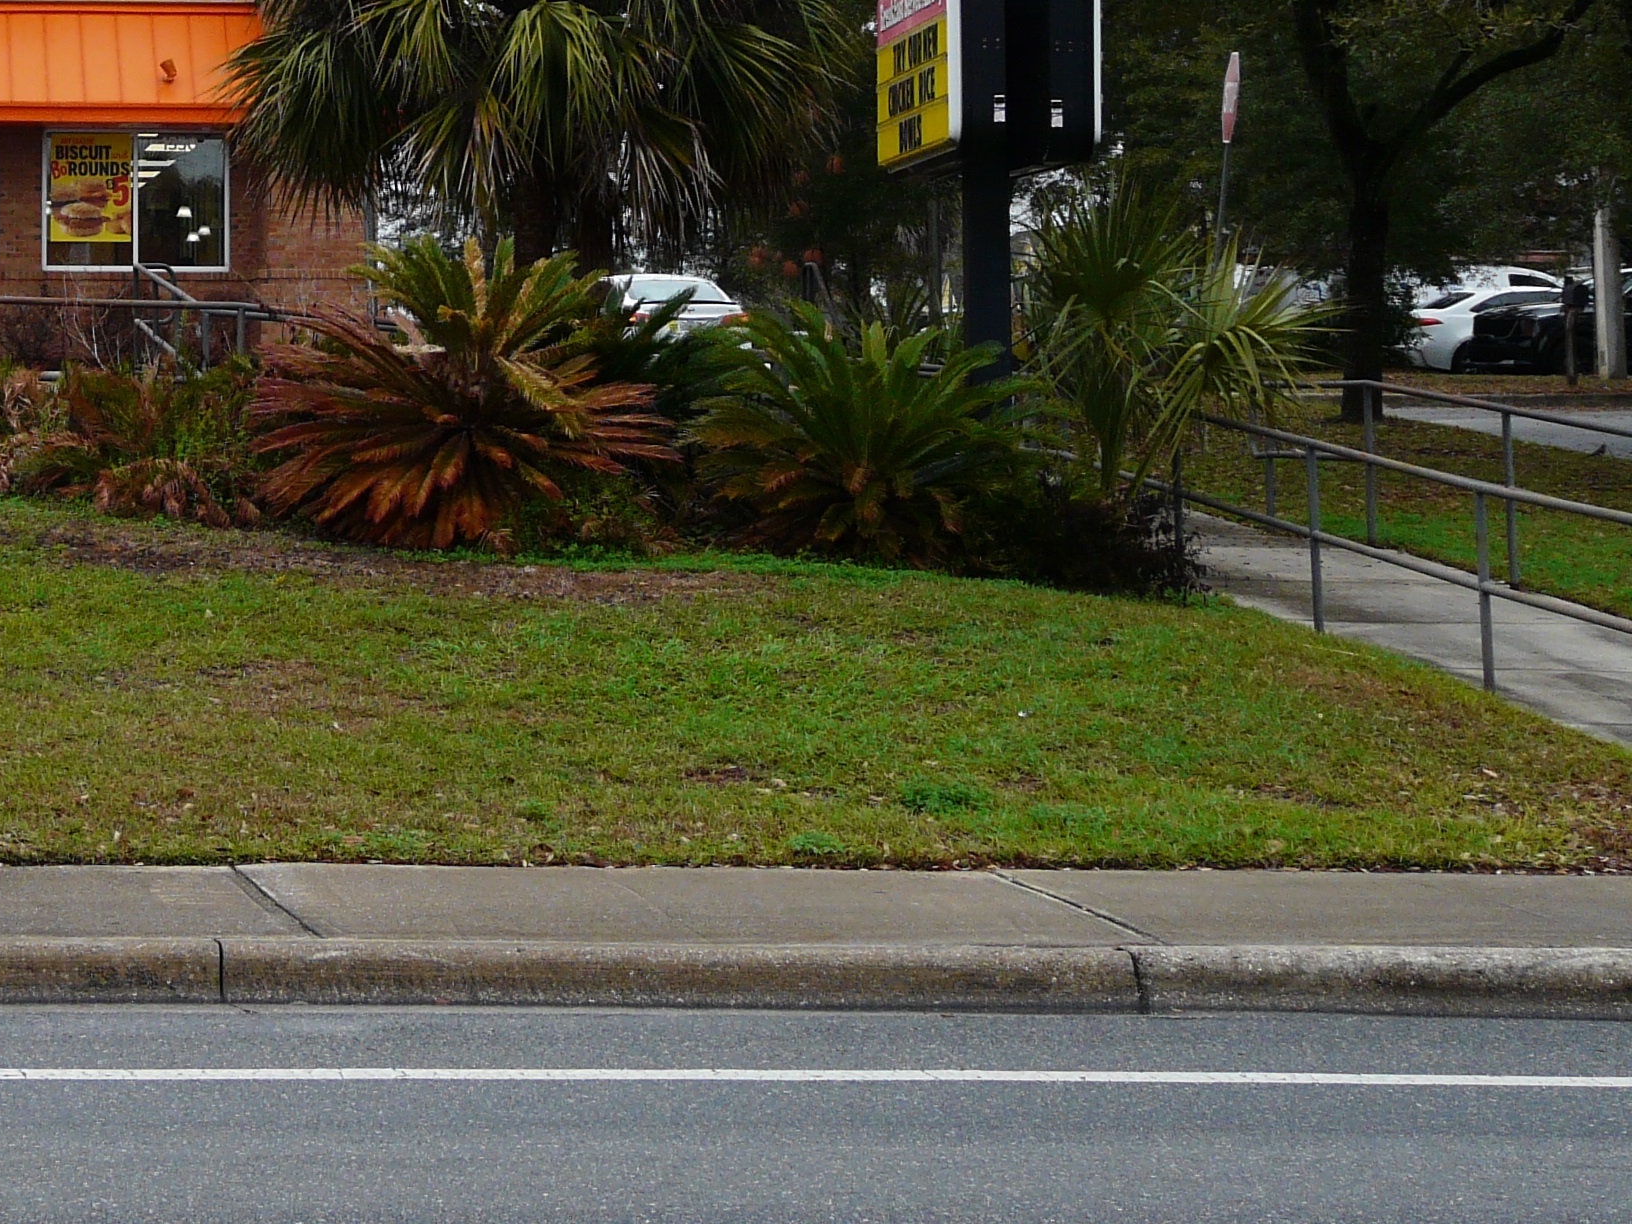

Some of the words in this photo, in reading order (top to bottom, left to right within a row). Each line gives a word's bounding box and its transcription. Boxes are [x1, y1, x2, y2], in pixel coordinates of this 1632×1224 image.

[893, 38, 906, 76] TRY
[908, 32, 922, 69] OUR
[923, 23, 938, 61] NEW
[889, 76, 915, 117] CHICKEN
[918, 66, 935, 105] RICE
[55, 145, 112, 160] BISCUIT
[899, 114, 922, 153] BOWLS
